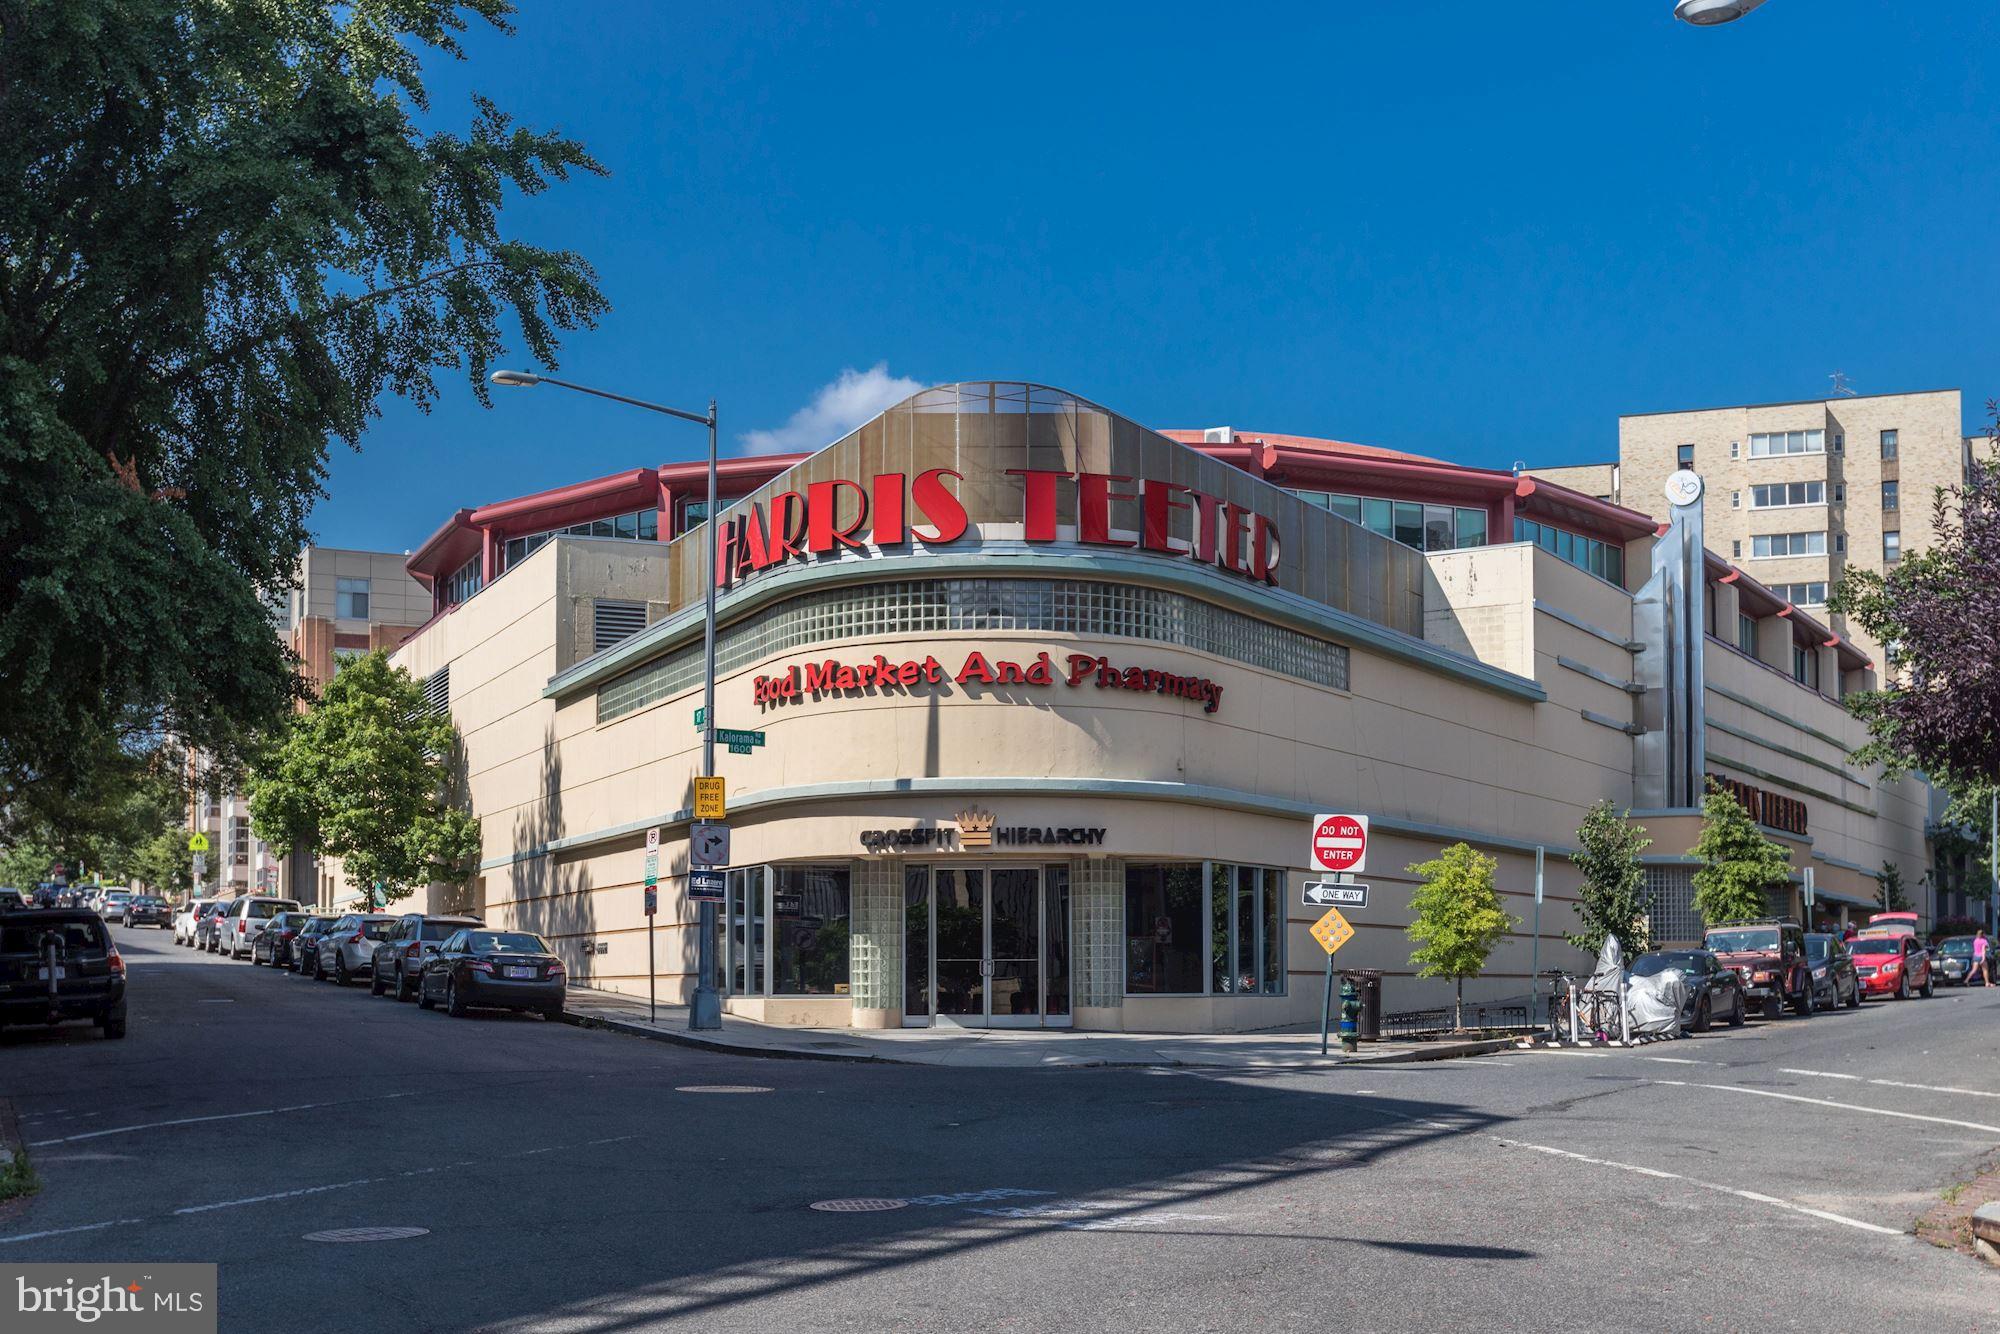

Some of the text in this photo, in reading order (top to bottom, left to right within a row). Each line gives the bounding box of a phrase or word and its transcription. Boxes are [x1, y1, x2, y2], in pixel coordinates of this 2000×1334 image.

[715, 468, 1282, 588] HARRIS TEETER
[753, 651, 1224, 713] Food Market And Pharmacy
[719, 730, 754, 744] Kalorama
[730, 744, 752, 753] 1600
[699, 782, 720, 790] DRUG
[700, 793, 719, 801] FREE
[1322, 826, 1359, 835] DO NOT
[860, 827, 1107, 846] CROSSFIT HIERARCHY
[1323, 850, 1353, 860] ENTER
[1322, 890, 1361, 900] ONE WAY
